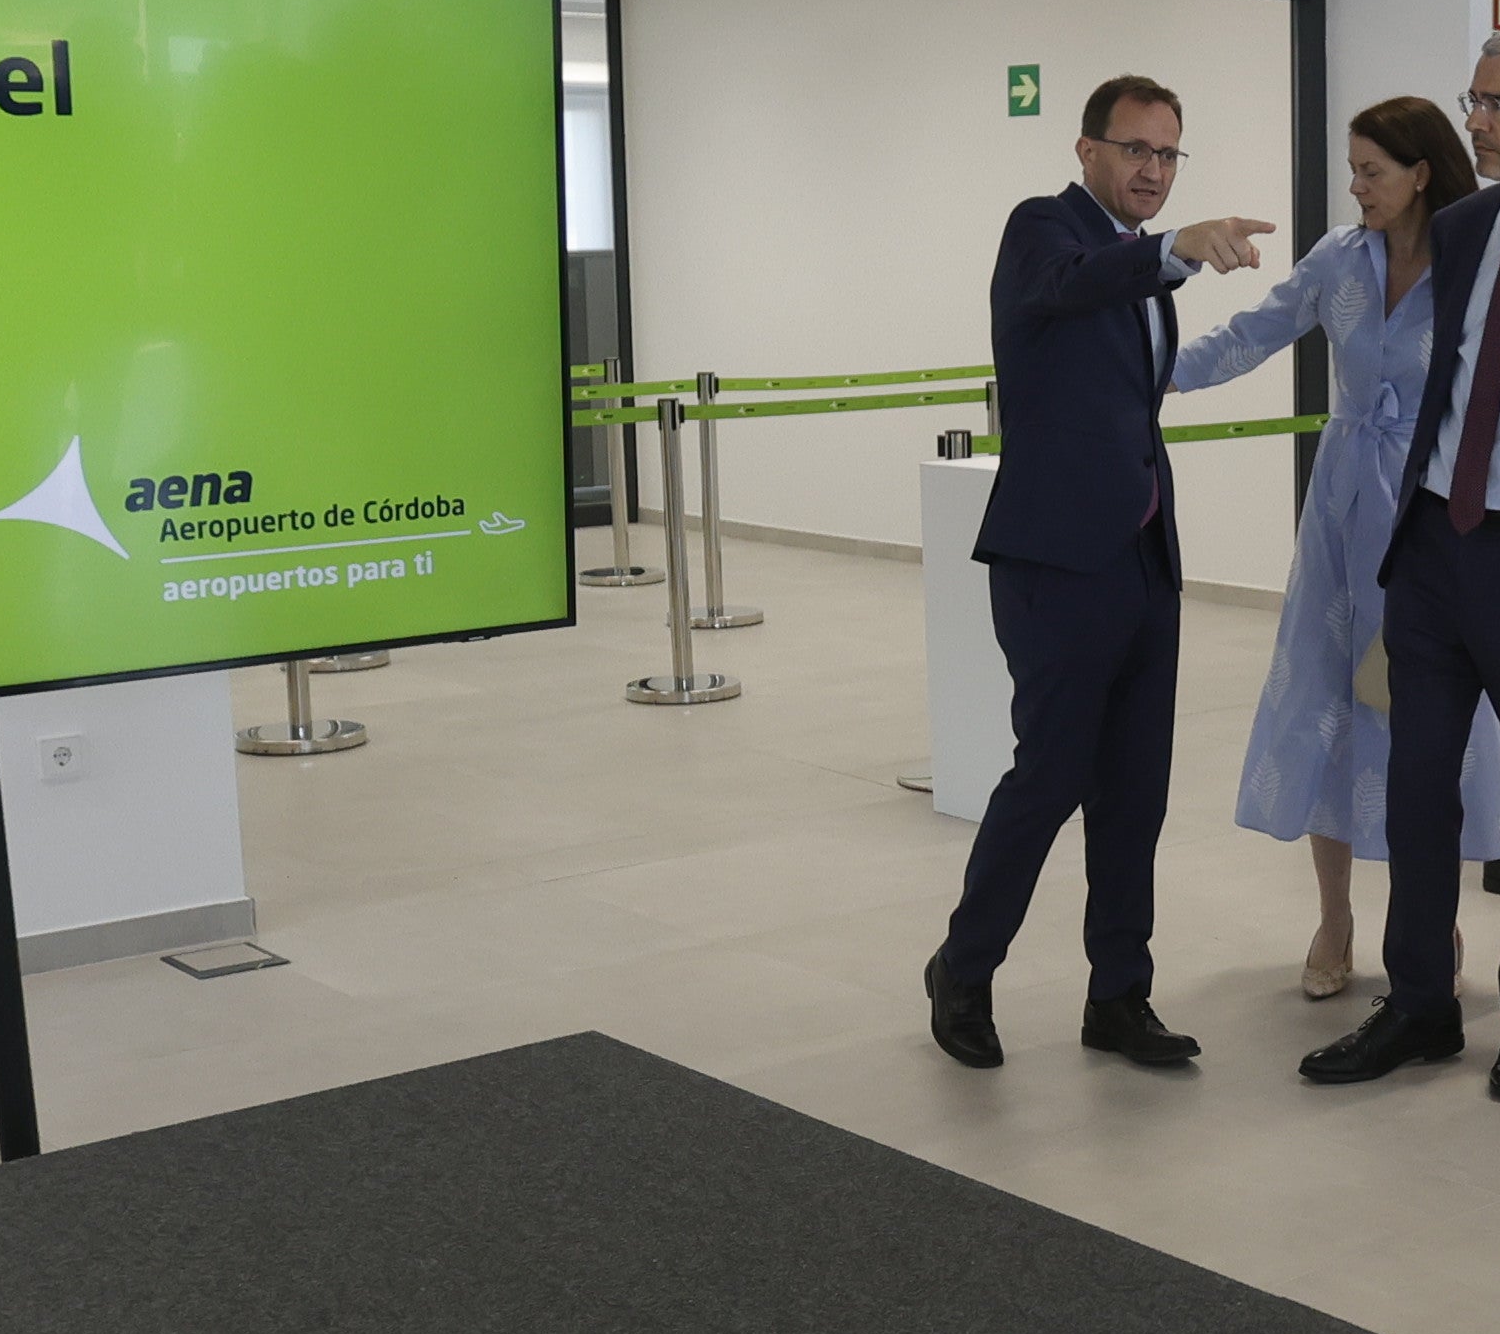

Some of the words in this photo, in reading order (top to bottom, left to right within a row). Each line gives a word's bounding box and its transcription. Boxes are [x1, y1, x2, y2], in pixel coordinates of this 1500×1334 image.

[124, 470, 253, 514] aena
[160, 511, 316, 544] Aeropuerto
[324, 502, 355, 527] de
[363, 494, 465, 525] Córdoba
[162, 567, 339, 603] aeropuertos
[347, 556, 406, 587] para
[414, 550, 434, 576] ti
